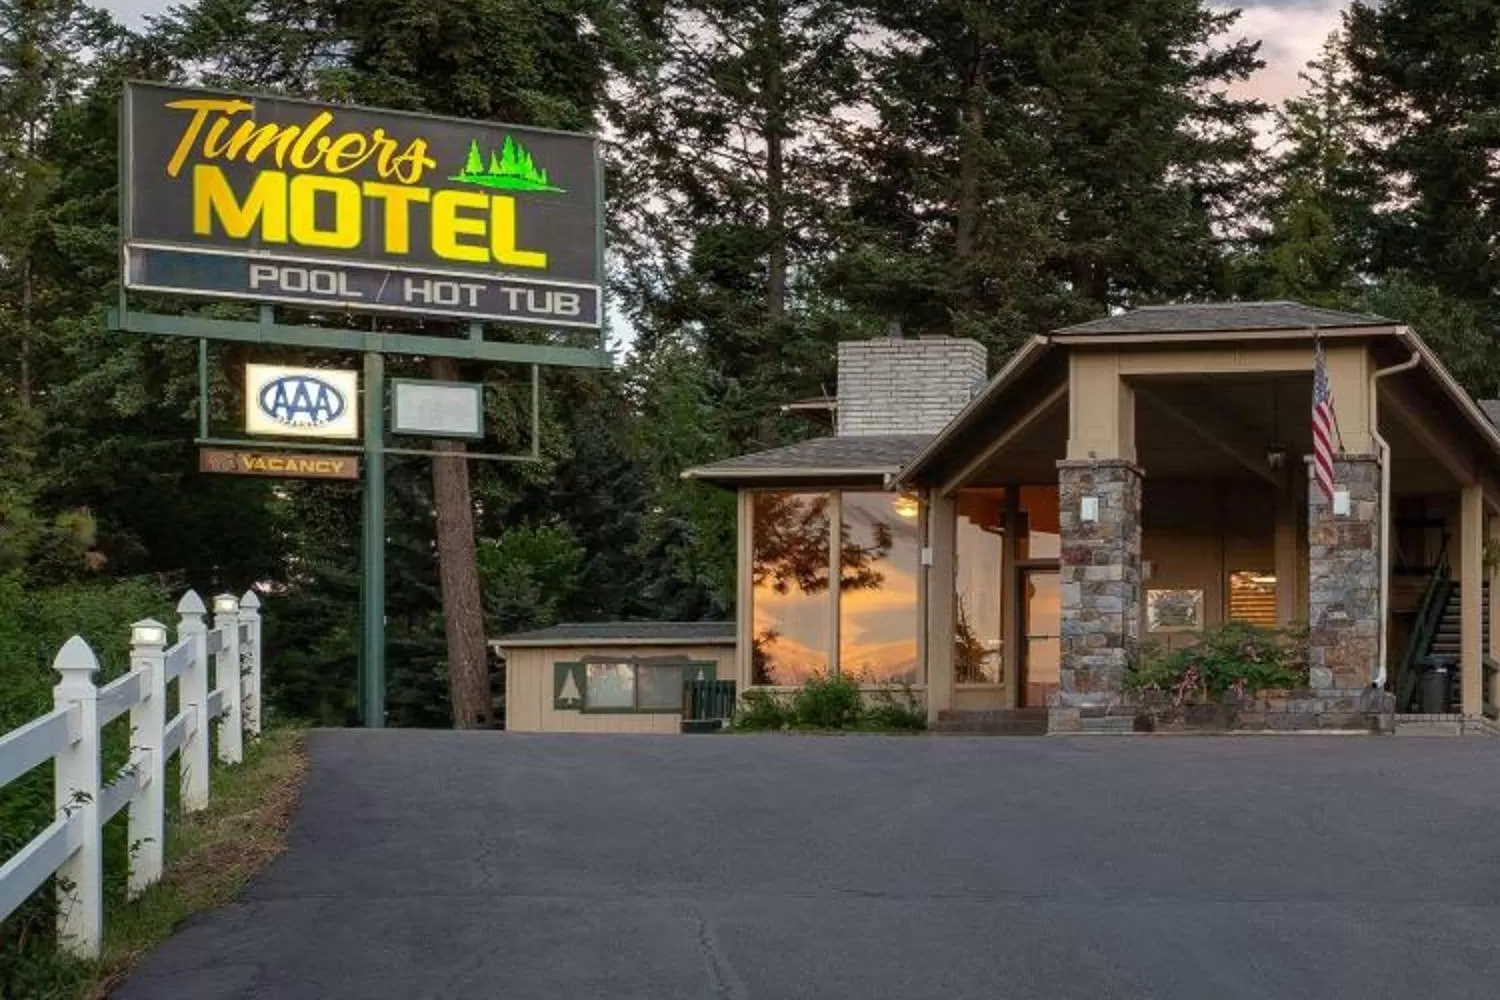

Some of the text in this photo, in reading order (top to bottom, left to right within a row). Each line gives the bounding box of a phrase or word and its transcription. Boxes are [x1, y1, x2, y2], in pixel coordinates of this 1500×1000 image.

[165, 99, 437, 184] Timbers
[193, 164, 547, 269] MOTEL
[250, 265, 363, 297] POOL
[403, 277, 487, 308] HOT
[501, 286, 581, 316] TUB
[272, 377, 333, 422] AAA
[242, 454, 345, 474] VACANCY
